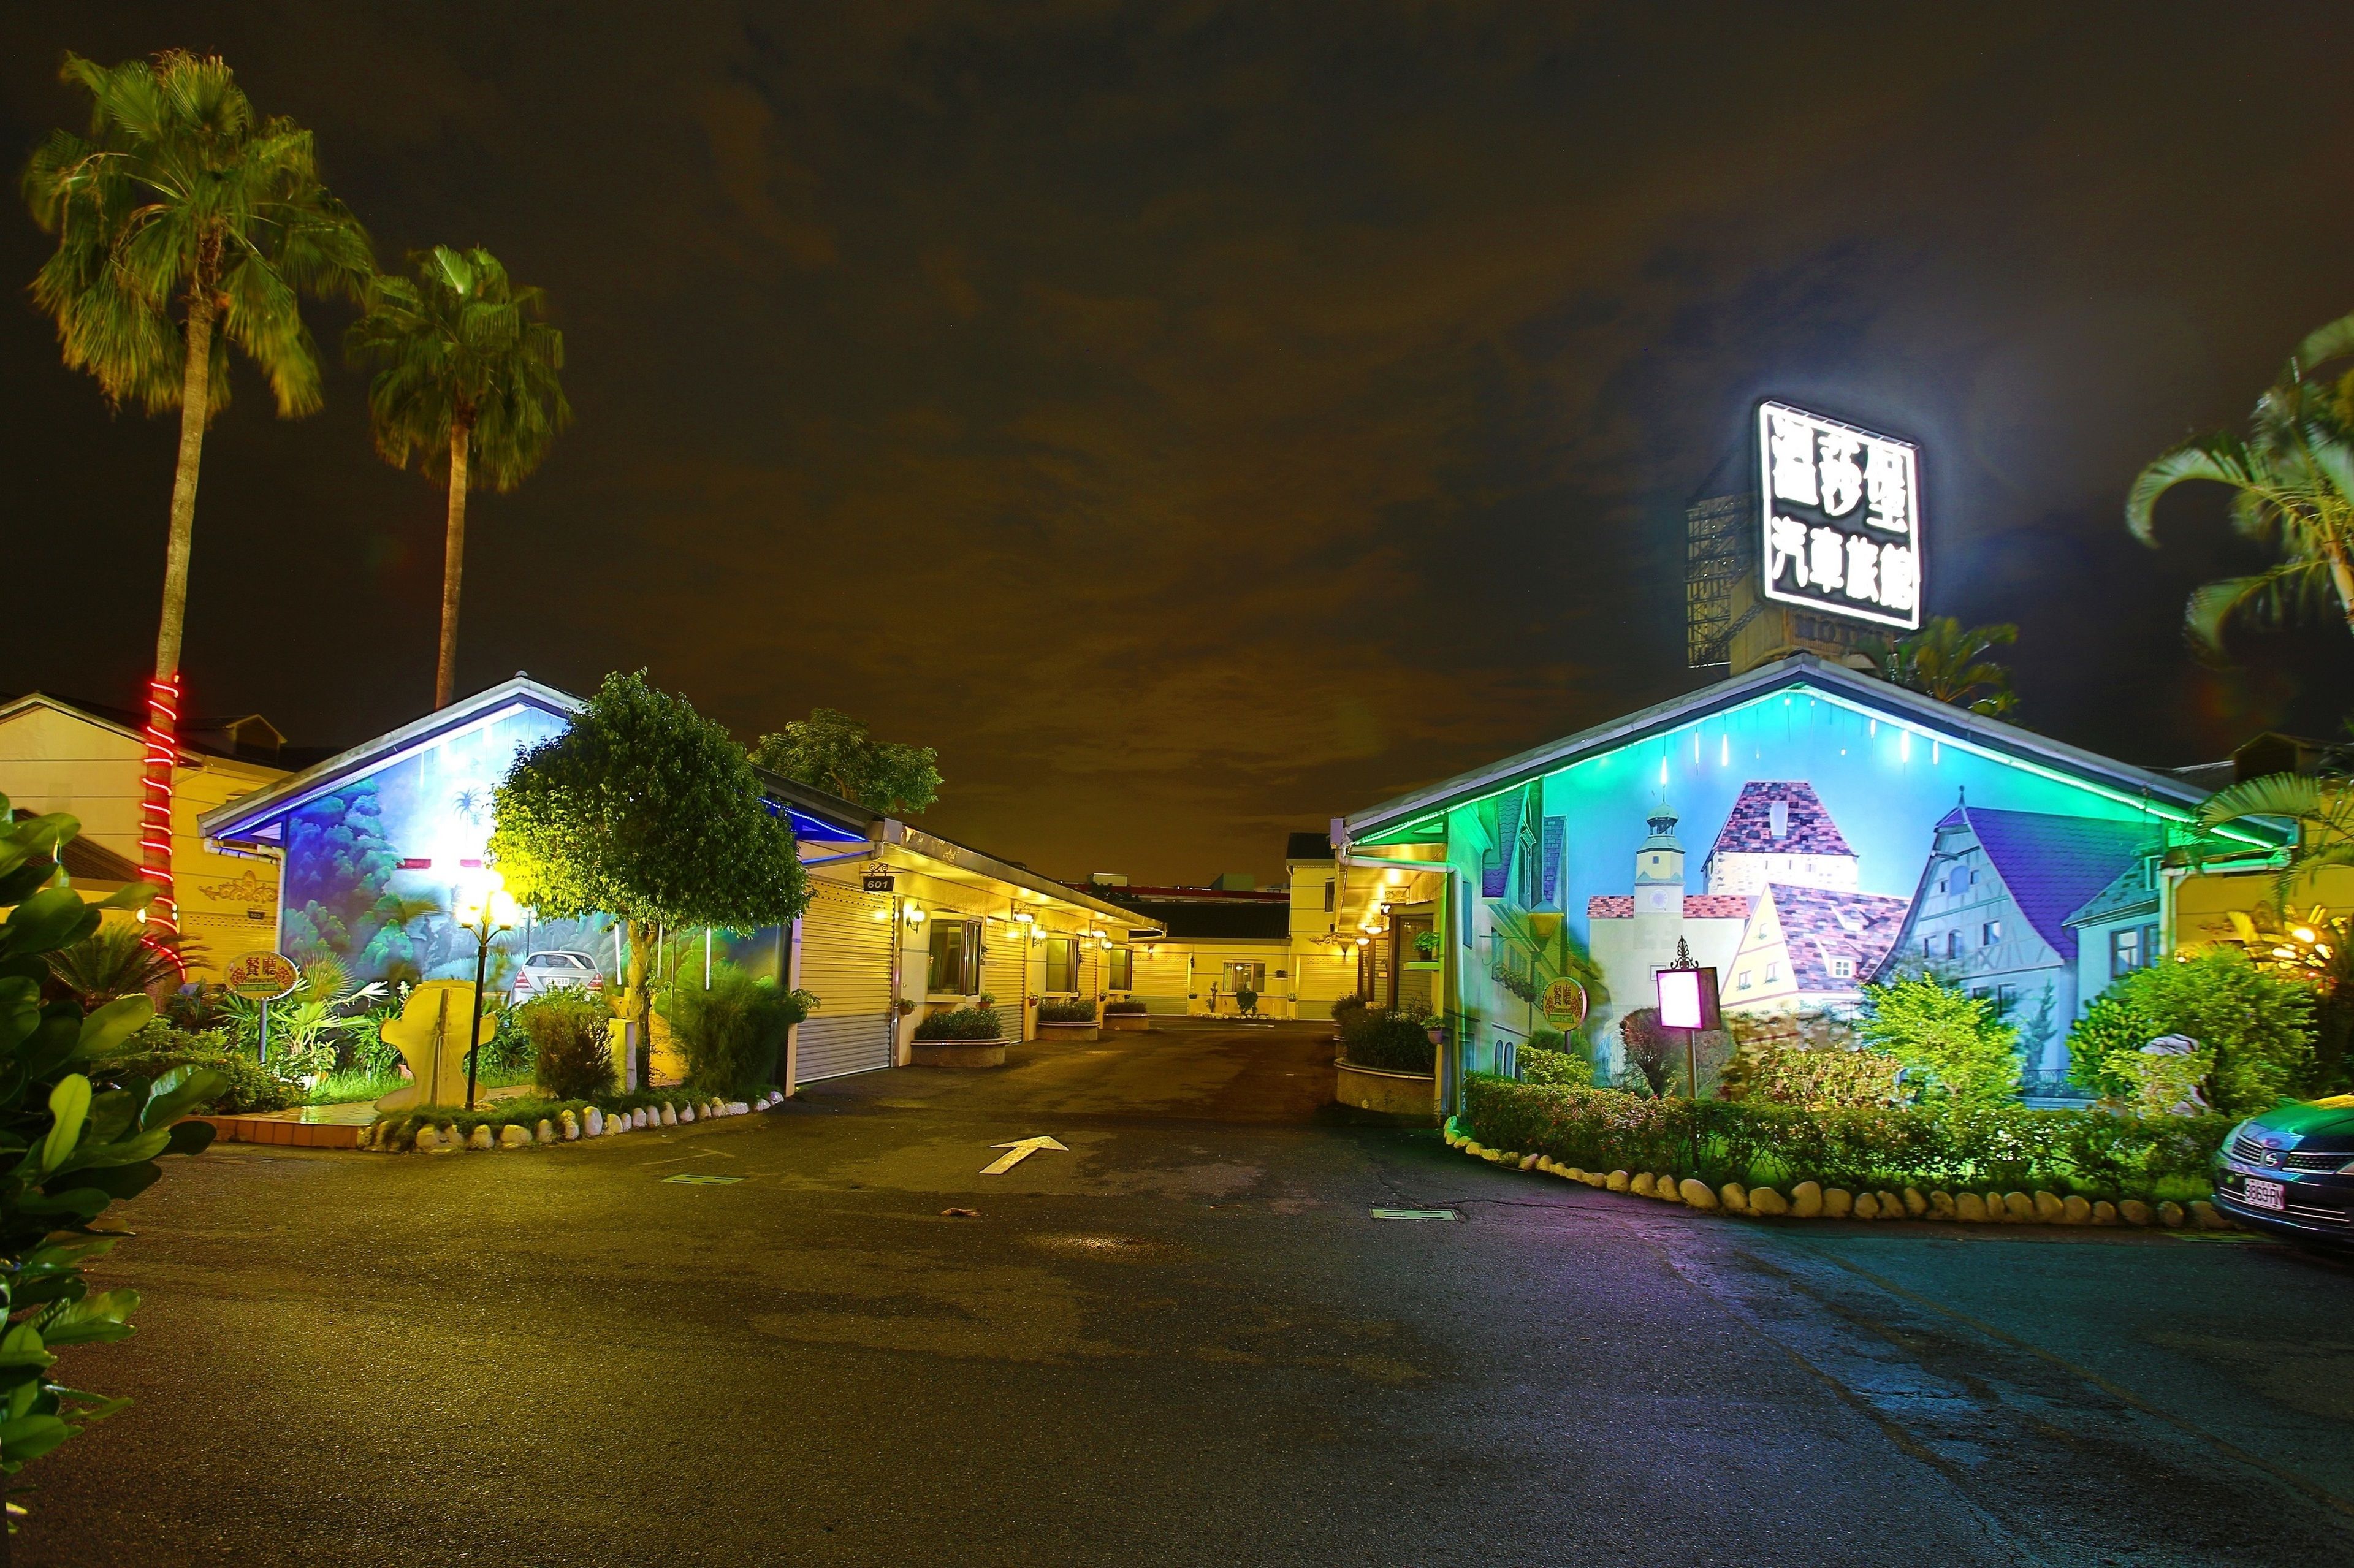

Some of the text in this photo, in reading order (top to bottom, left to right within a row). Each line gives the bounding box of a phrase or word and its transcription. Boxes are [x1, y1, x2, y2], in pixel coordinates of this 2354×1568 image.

[1771, 516, 1912, 610] 汽車旅館
[246, 956, 277, 976] 餐廳
[1554, 984, 1571, 1006] 餐廳
